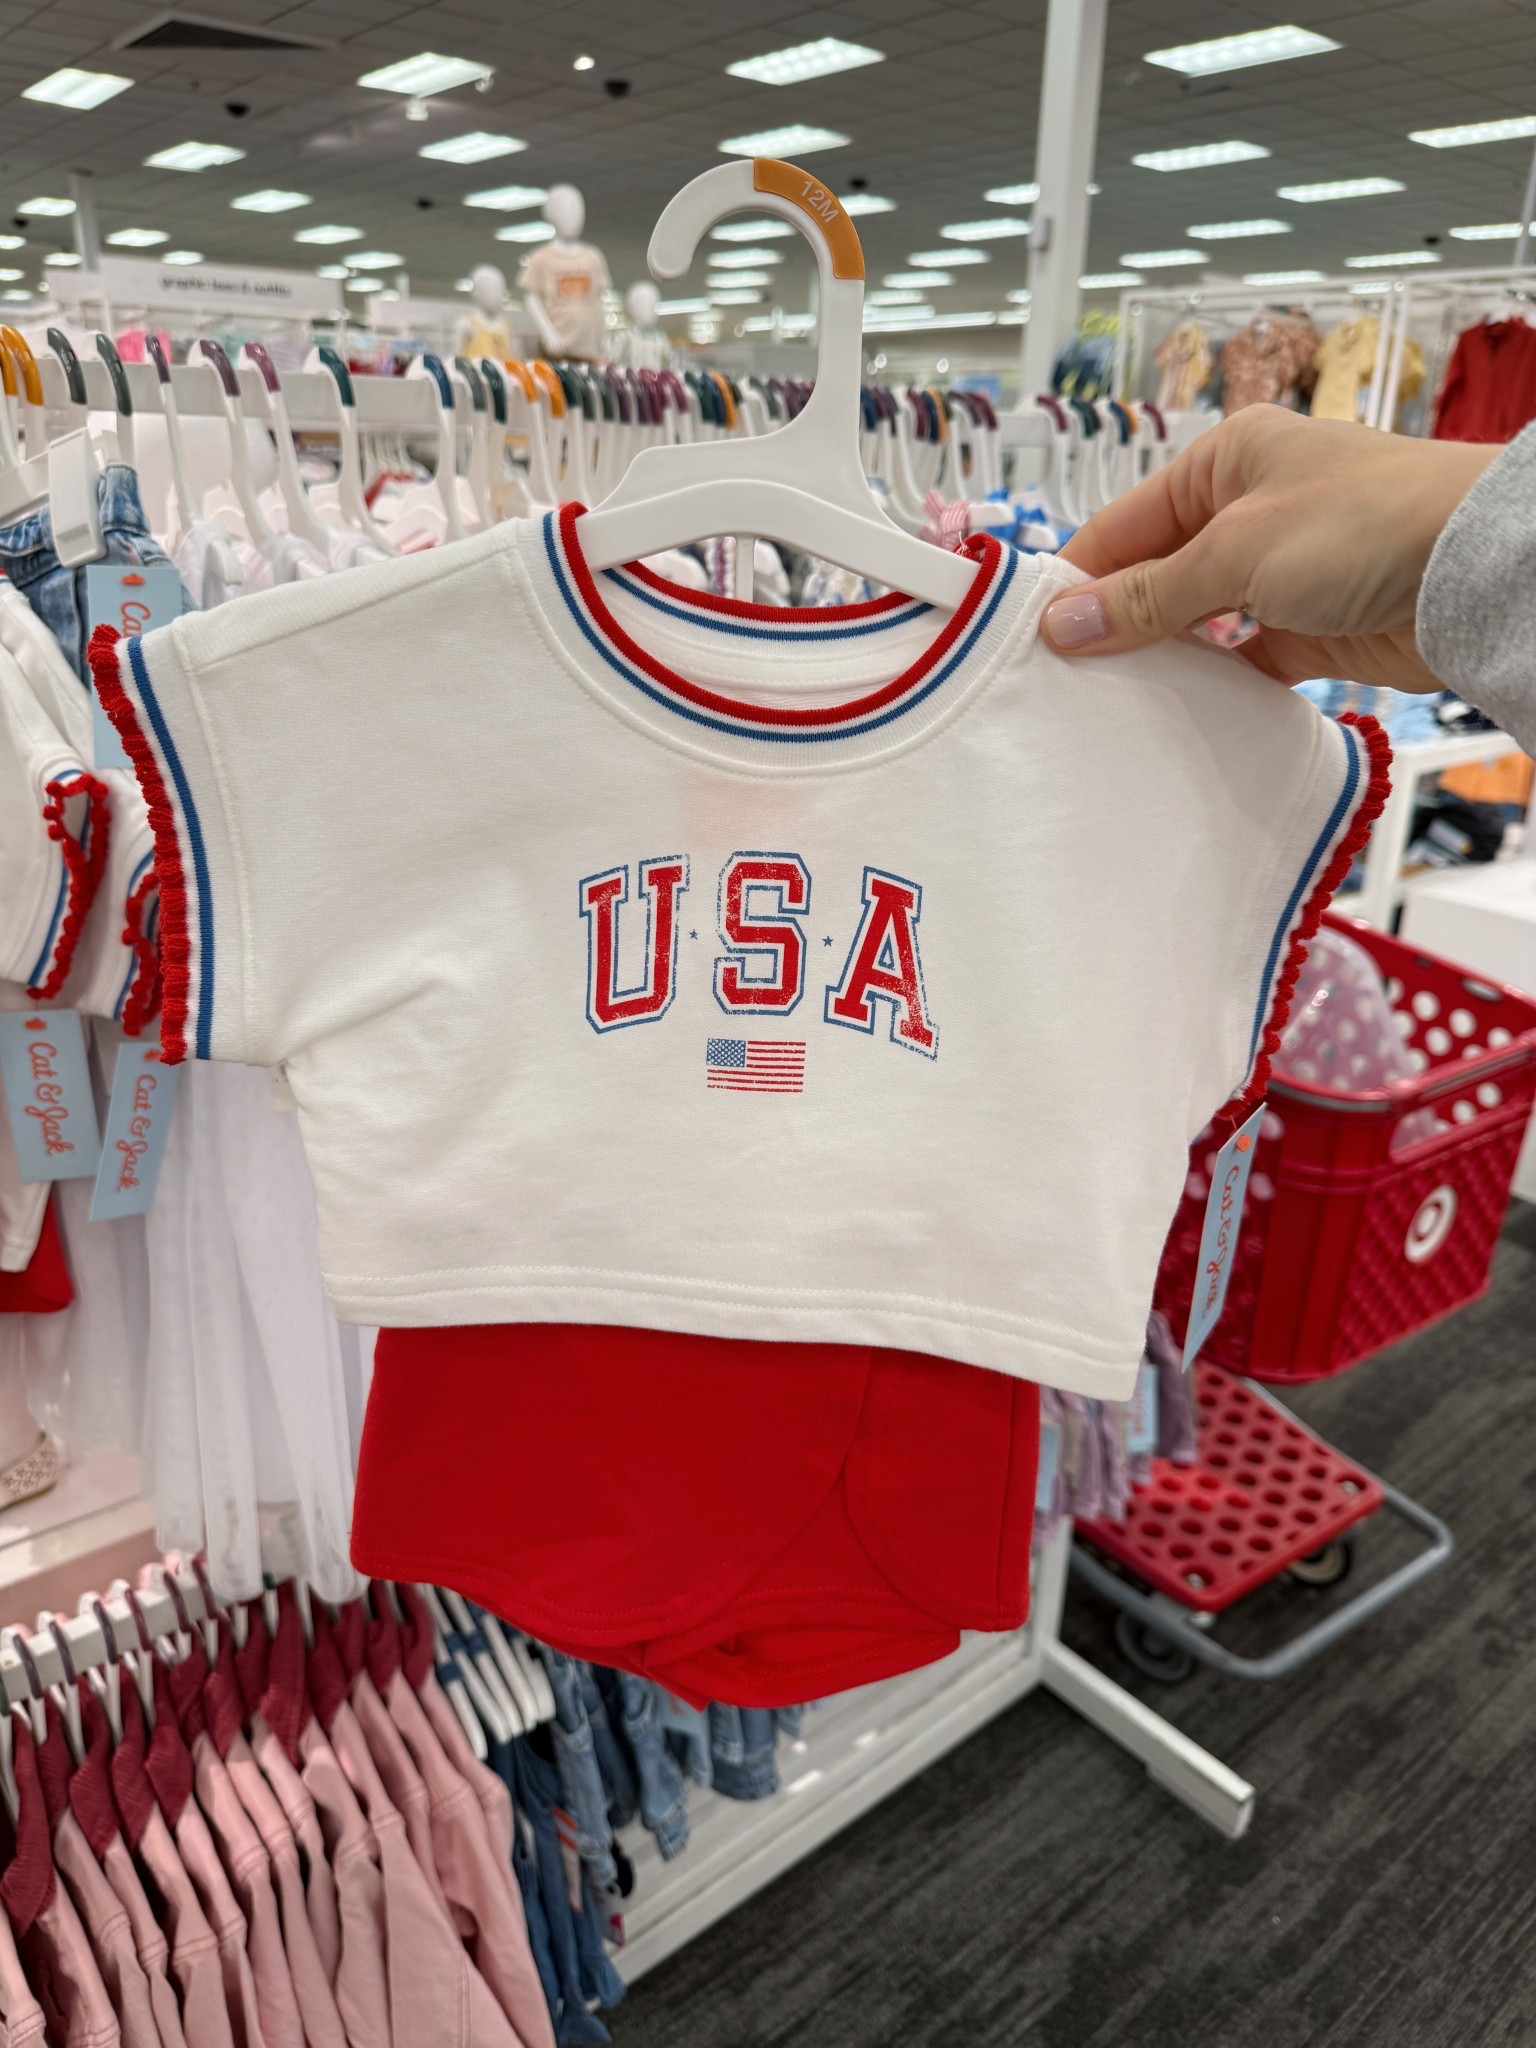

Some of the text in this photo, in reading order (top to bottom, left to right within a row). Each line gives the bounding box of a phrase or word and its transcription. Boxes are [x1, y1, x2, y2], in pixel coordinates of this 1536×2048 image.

[801, 180, 840, 223] 12M
[120, 601, 151, 638] Ca
[23, 1041, 75, 1156] Cat & Jack
[115, 1073, 157, 1193] Cat & Jack
[1220, 1164, 1240, 1220] Cat
